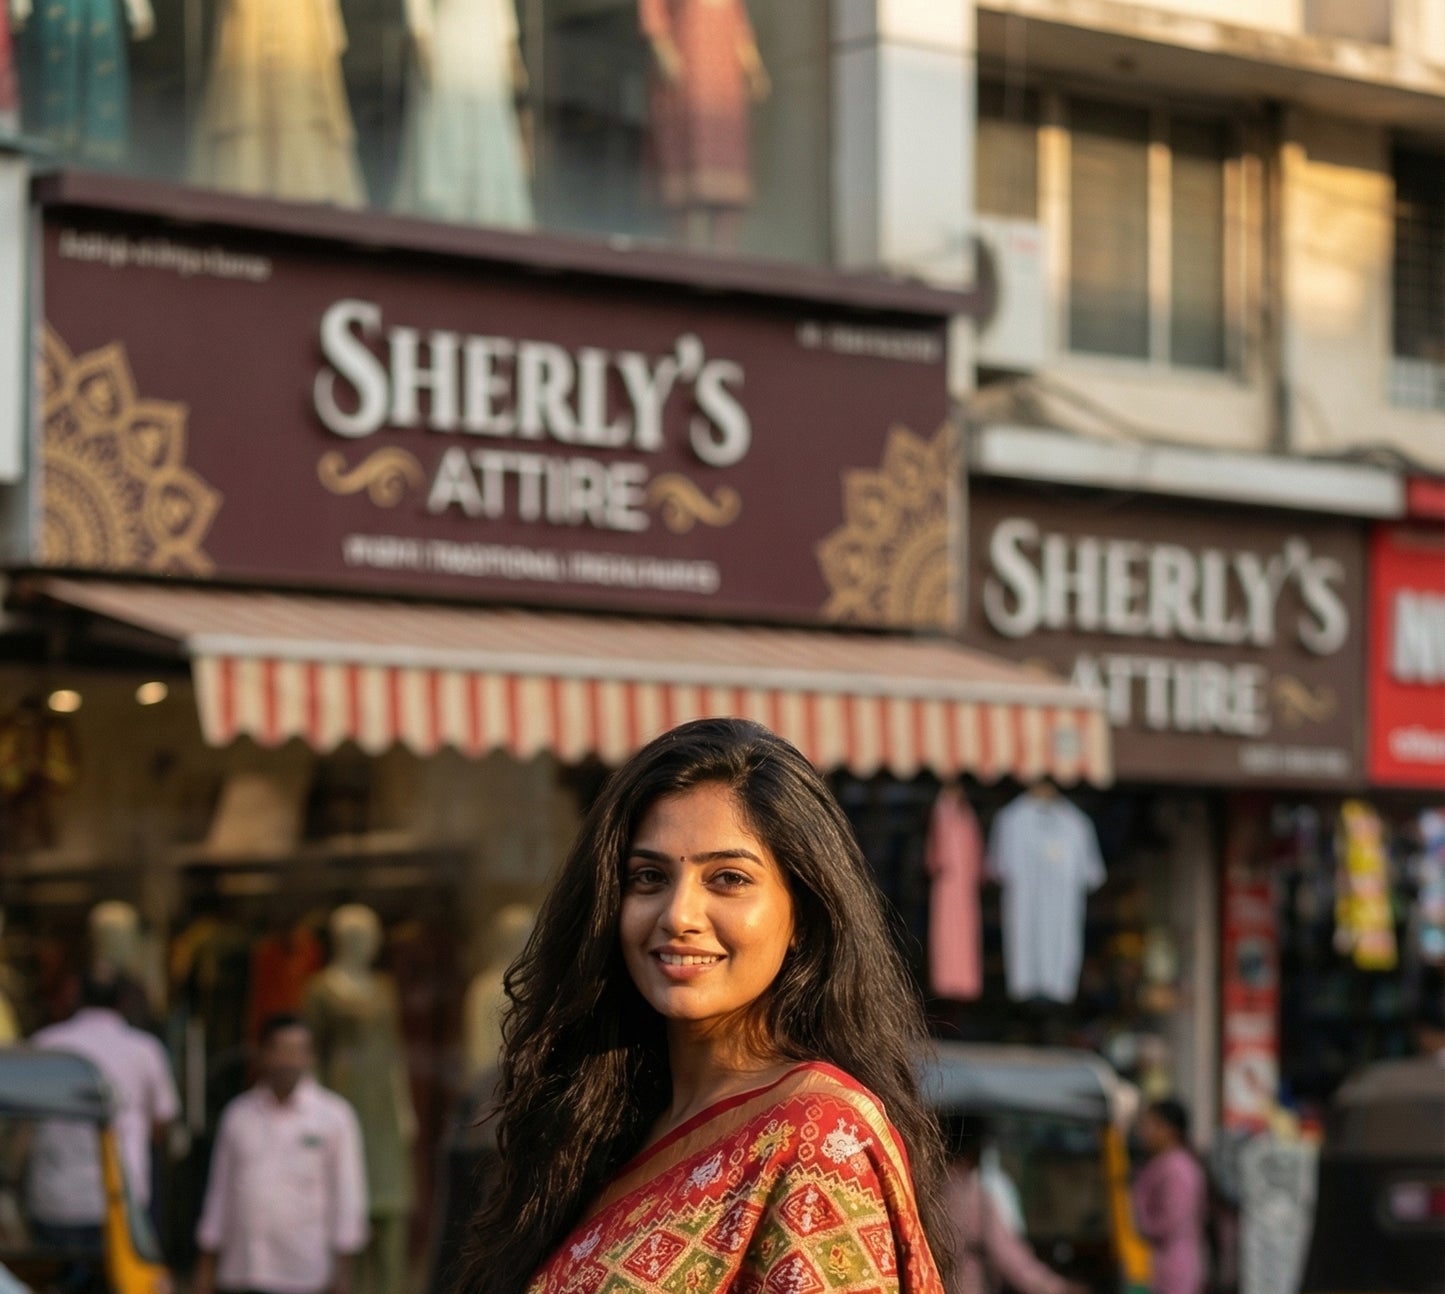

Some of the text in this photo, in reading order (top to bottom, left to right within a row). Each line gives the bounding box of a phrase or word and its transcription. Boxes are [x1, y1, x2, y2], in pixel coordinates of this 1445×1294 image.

[314, 298, 751, 467] SHERLY'S
[427, 446, 650, 532] ATTIRE
[983, 517, 1349, 655] SHERLY'S
